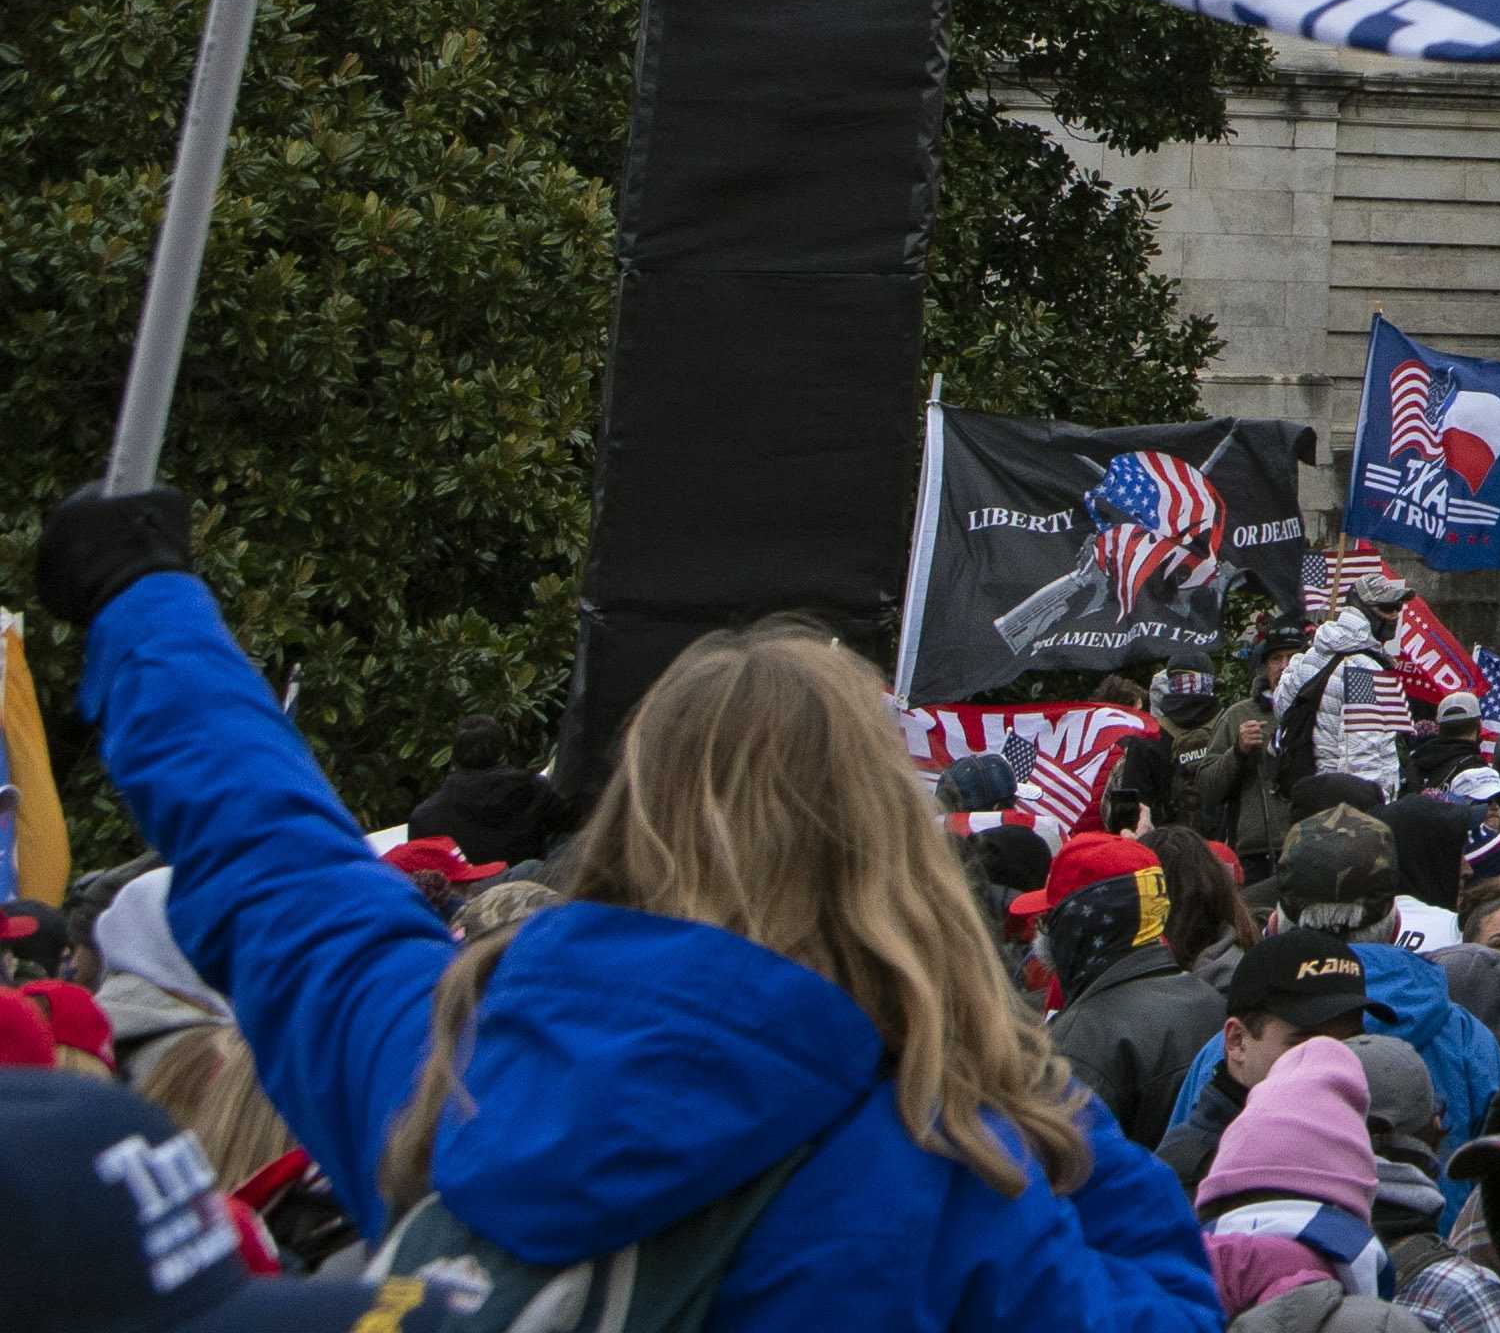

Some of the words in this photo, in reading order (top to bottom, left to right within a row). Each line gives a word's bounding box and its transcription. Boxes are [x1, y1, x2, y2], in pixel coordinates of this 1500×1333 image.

[968, 507, 1075, 533] LIBERTY
[1233, 525, 1258, 548] OR
[1260, 517, 1302, 542] DEATH
[1170, 626, 1220, 645] 1789
[1179, 747, 1208, 765] CIVILI
[1296, 957, 1361, 980] KAHR
